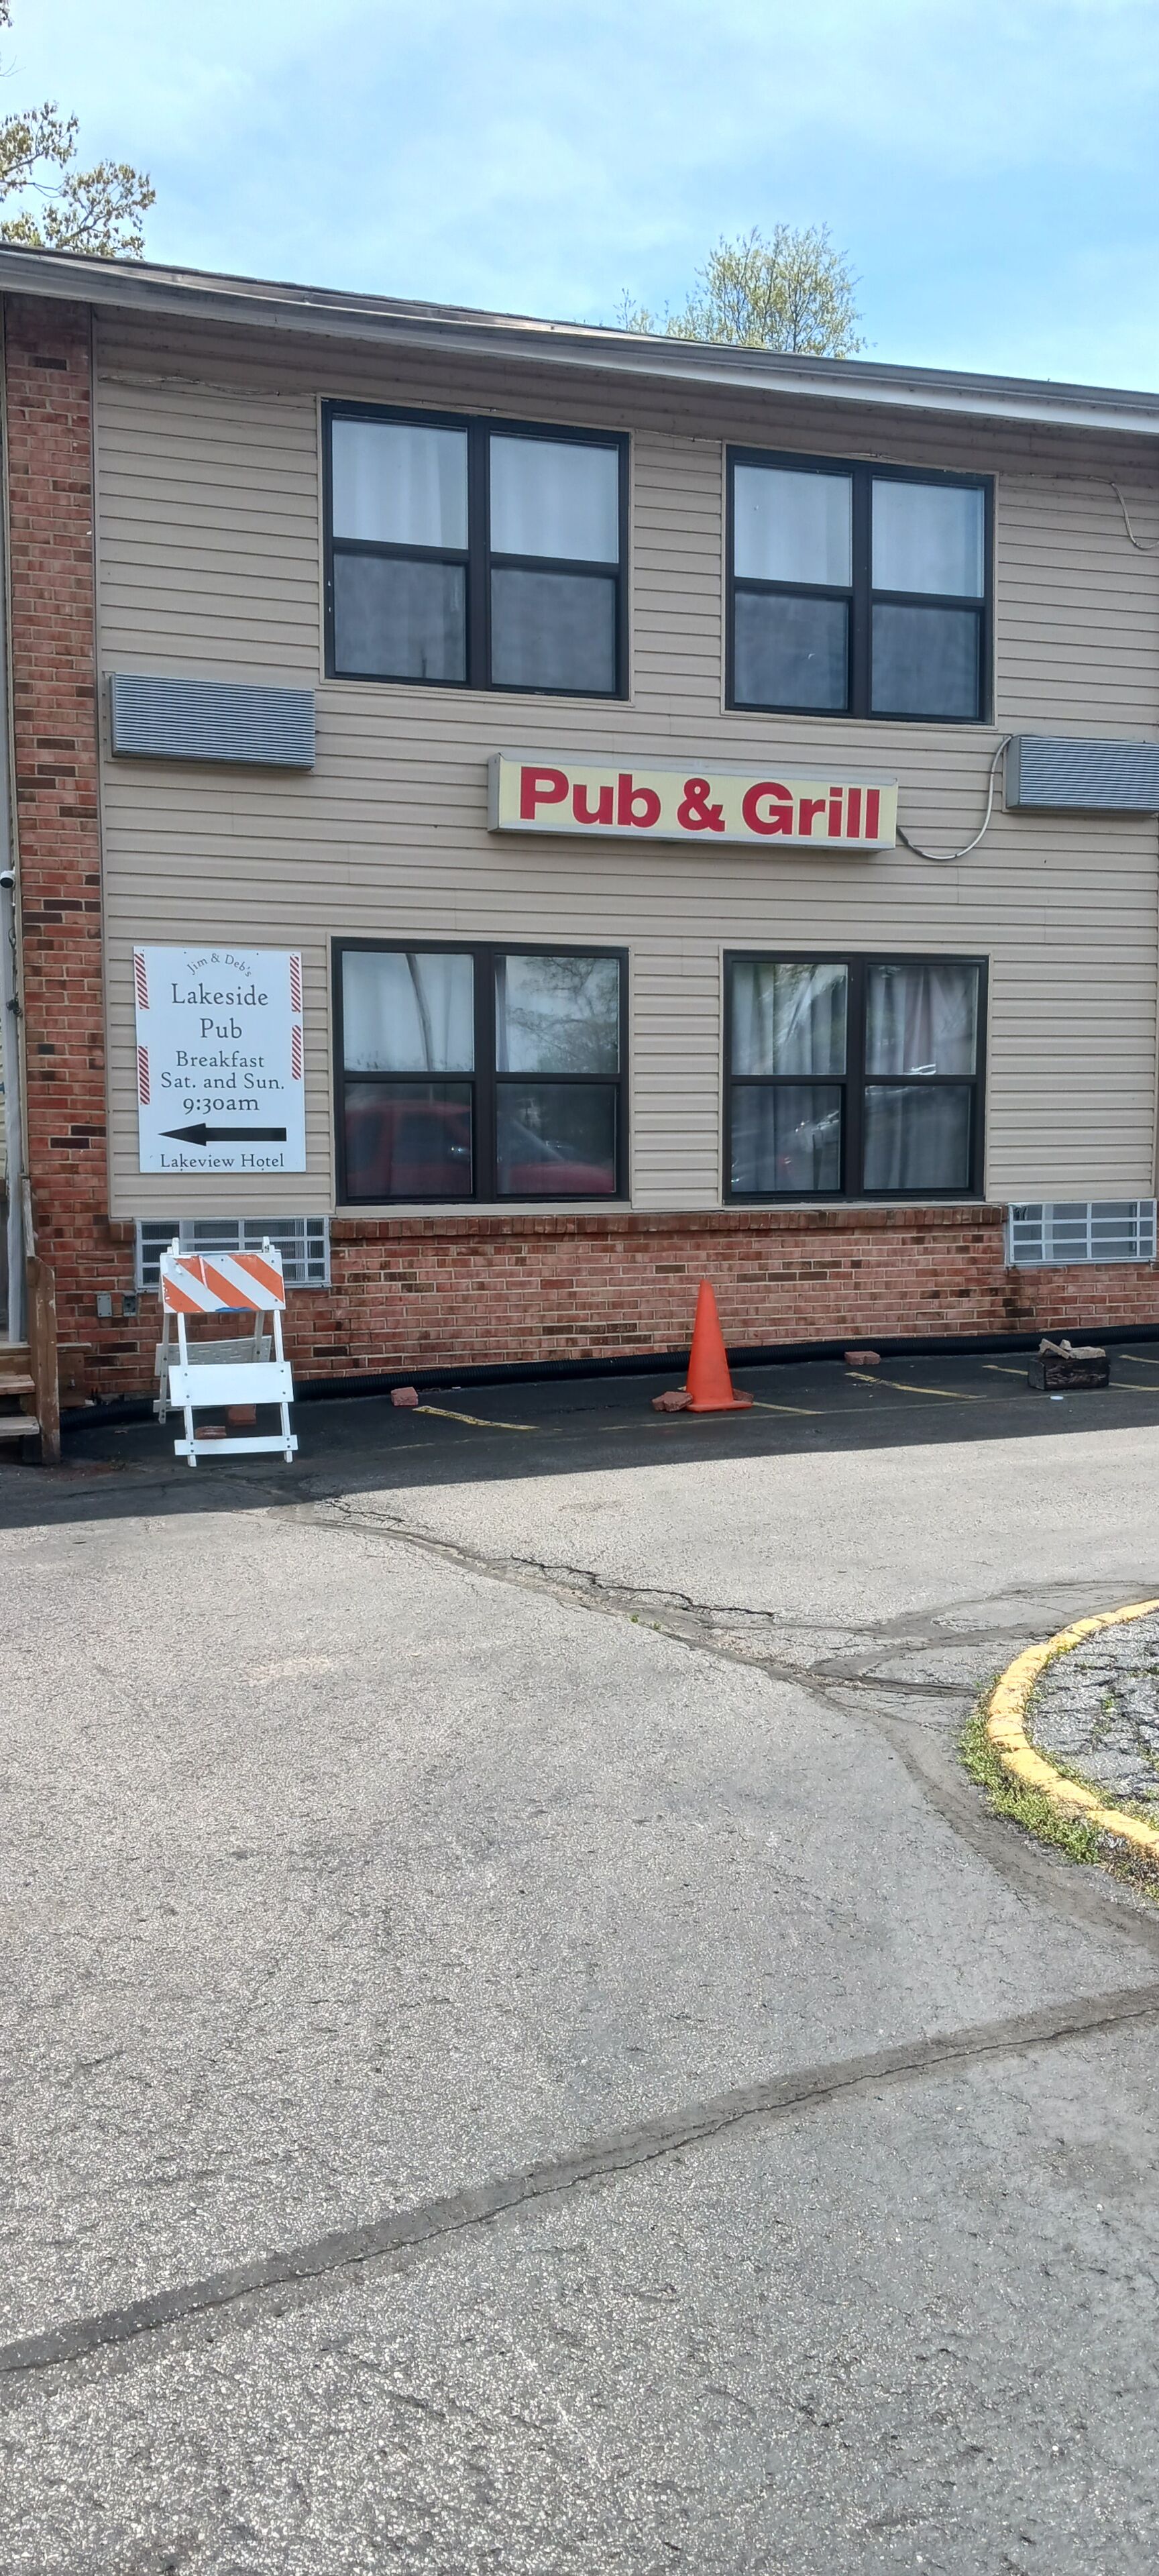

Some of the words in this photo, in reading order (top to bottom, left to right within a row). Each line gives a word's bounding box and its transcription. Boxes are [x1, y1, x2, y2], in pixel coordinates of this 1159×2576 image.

[519, 765, 661, 828] Pub
[676, 777, 726, 833] &
[741, 781, 881, 839] Grill
[186, 958, 208, 975] Jim
[211, 953, 221, 963] &
[225, 954, 252, 977] Deb's
[171, 983, 269, 1006] Lakeside
[199, 1018, 243, 1039] Pub
[176, 1051, 265, 1068] Breakfast
[160, 1071, 197, 1089] Sat.
[203, 1072, 237, 1089] and
[243, 1073, 285, 1090] Sun.
[182, 1097, 260, 1116] 9:30am
[160, 1153, 235, 1168] Lakeview
[241, 1153, 285, 1168] Hotel
